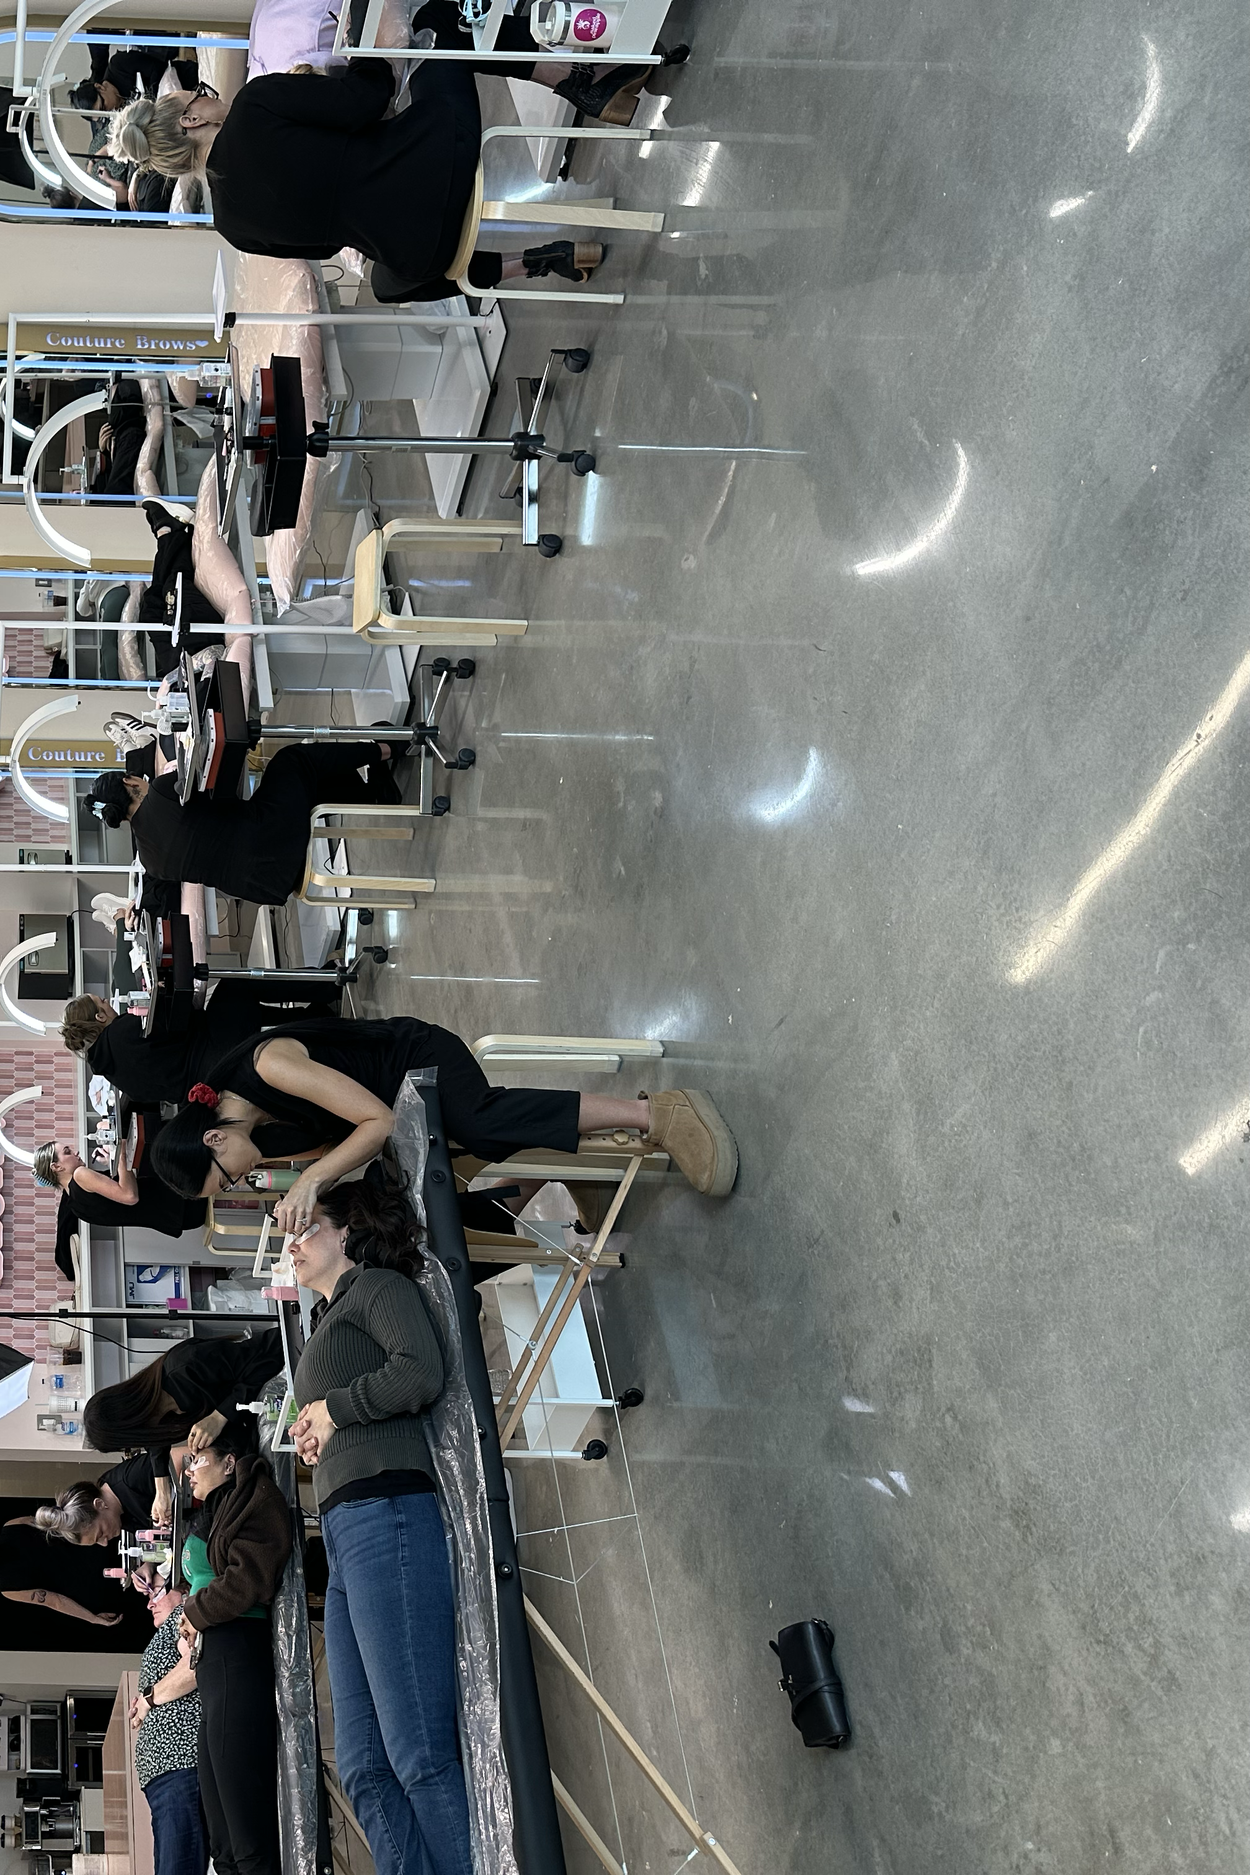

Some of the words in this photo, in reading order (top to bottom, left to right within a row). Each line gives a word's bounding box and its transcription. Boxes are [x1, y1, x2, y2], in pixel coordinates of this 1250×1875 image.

[46, 332, 126, 348] Couture
[136, 335, 196, 350] Brows
[28, 746, 106, 762] Couture
